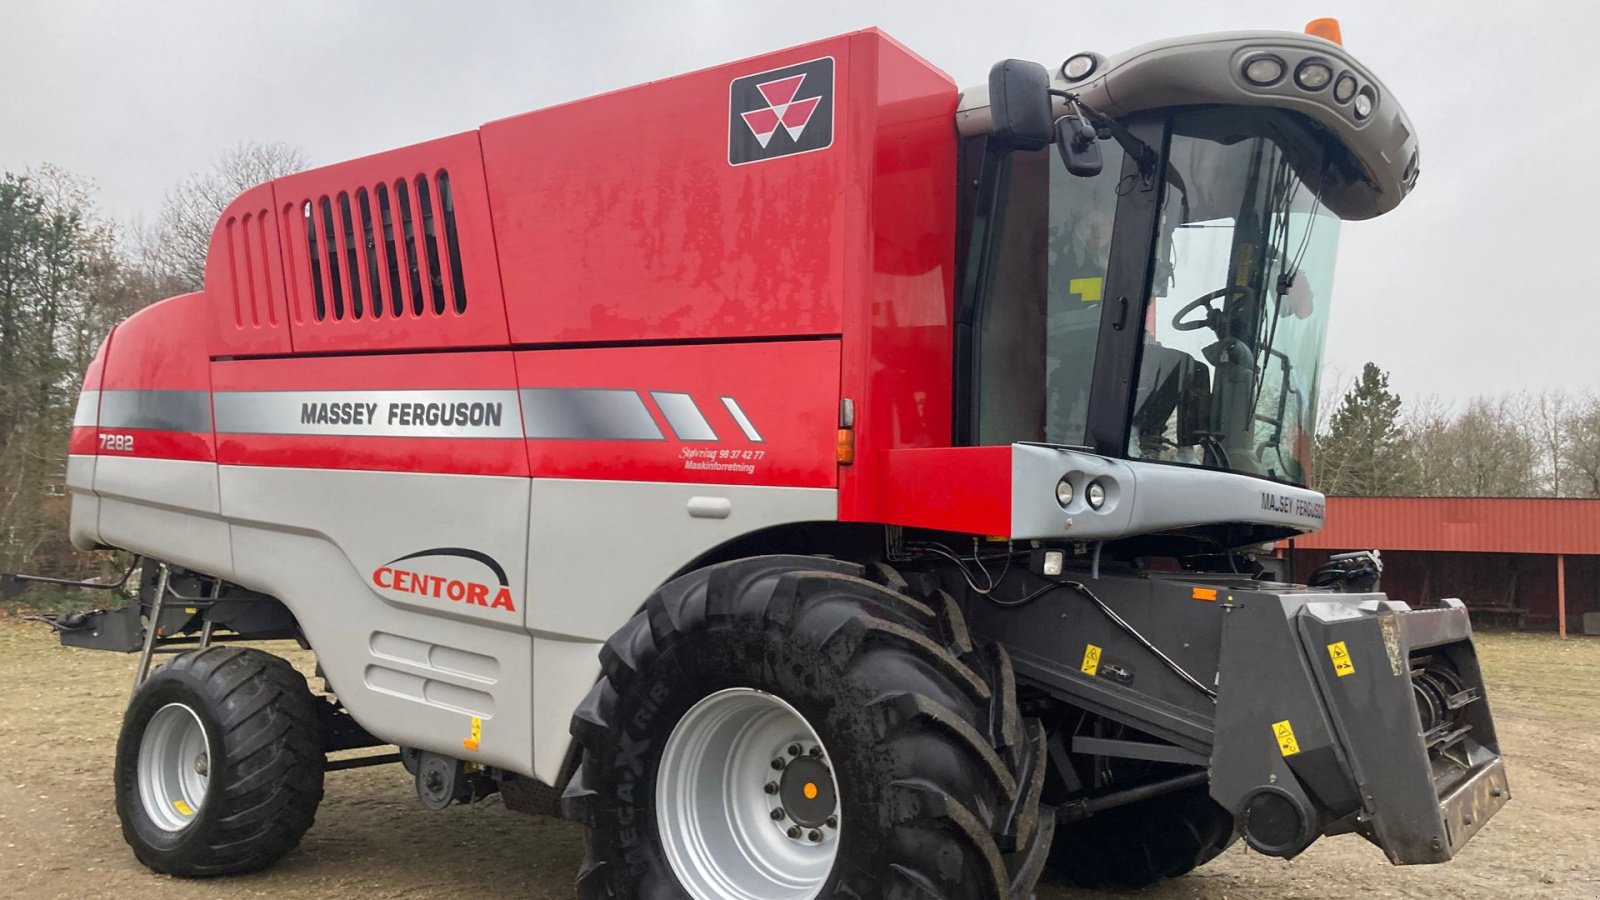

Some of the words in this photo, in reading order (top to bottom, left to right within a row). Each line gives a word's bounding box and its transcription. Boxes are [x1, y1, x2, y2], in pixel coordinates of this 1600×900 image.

[300, 402, 377, 425] MASSEY
[387, 402, 502, 427] FERGUSON
[99, 433, 134, 451] 7282
[678, 446, 718, 462] Støvring
[719, 450, 729, 459] 98
[730, 450, 741, 459] 37
[741, 450, 753, 460] 42
[753, 451, 765, 460] 77
[685, 461, 755, 474] Maskinforretning
[372, 567, 516, 612] CENTORA
